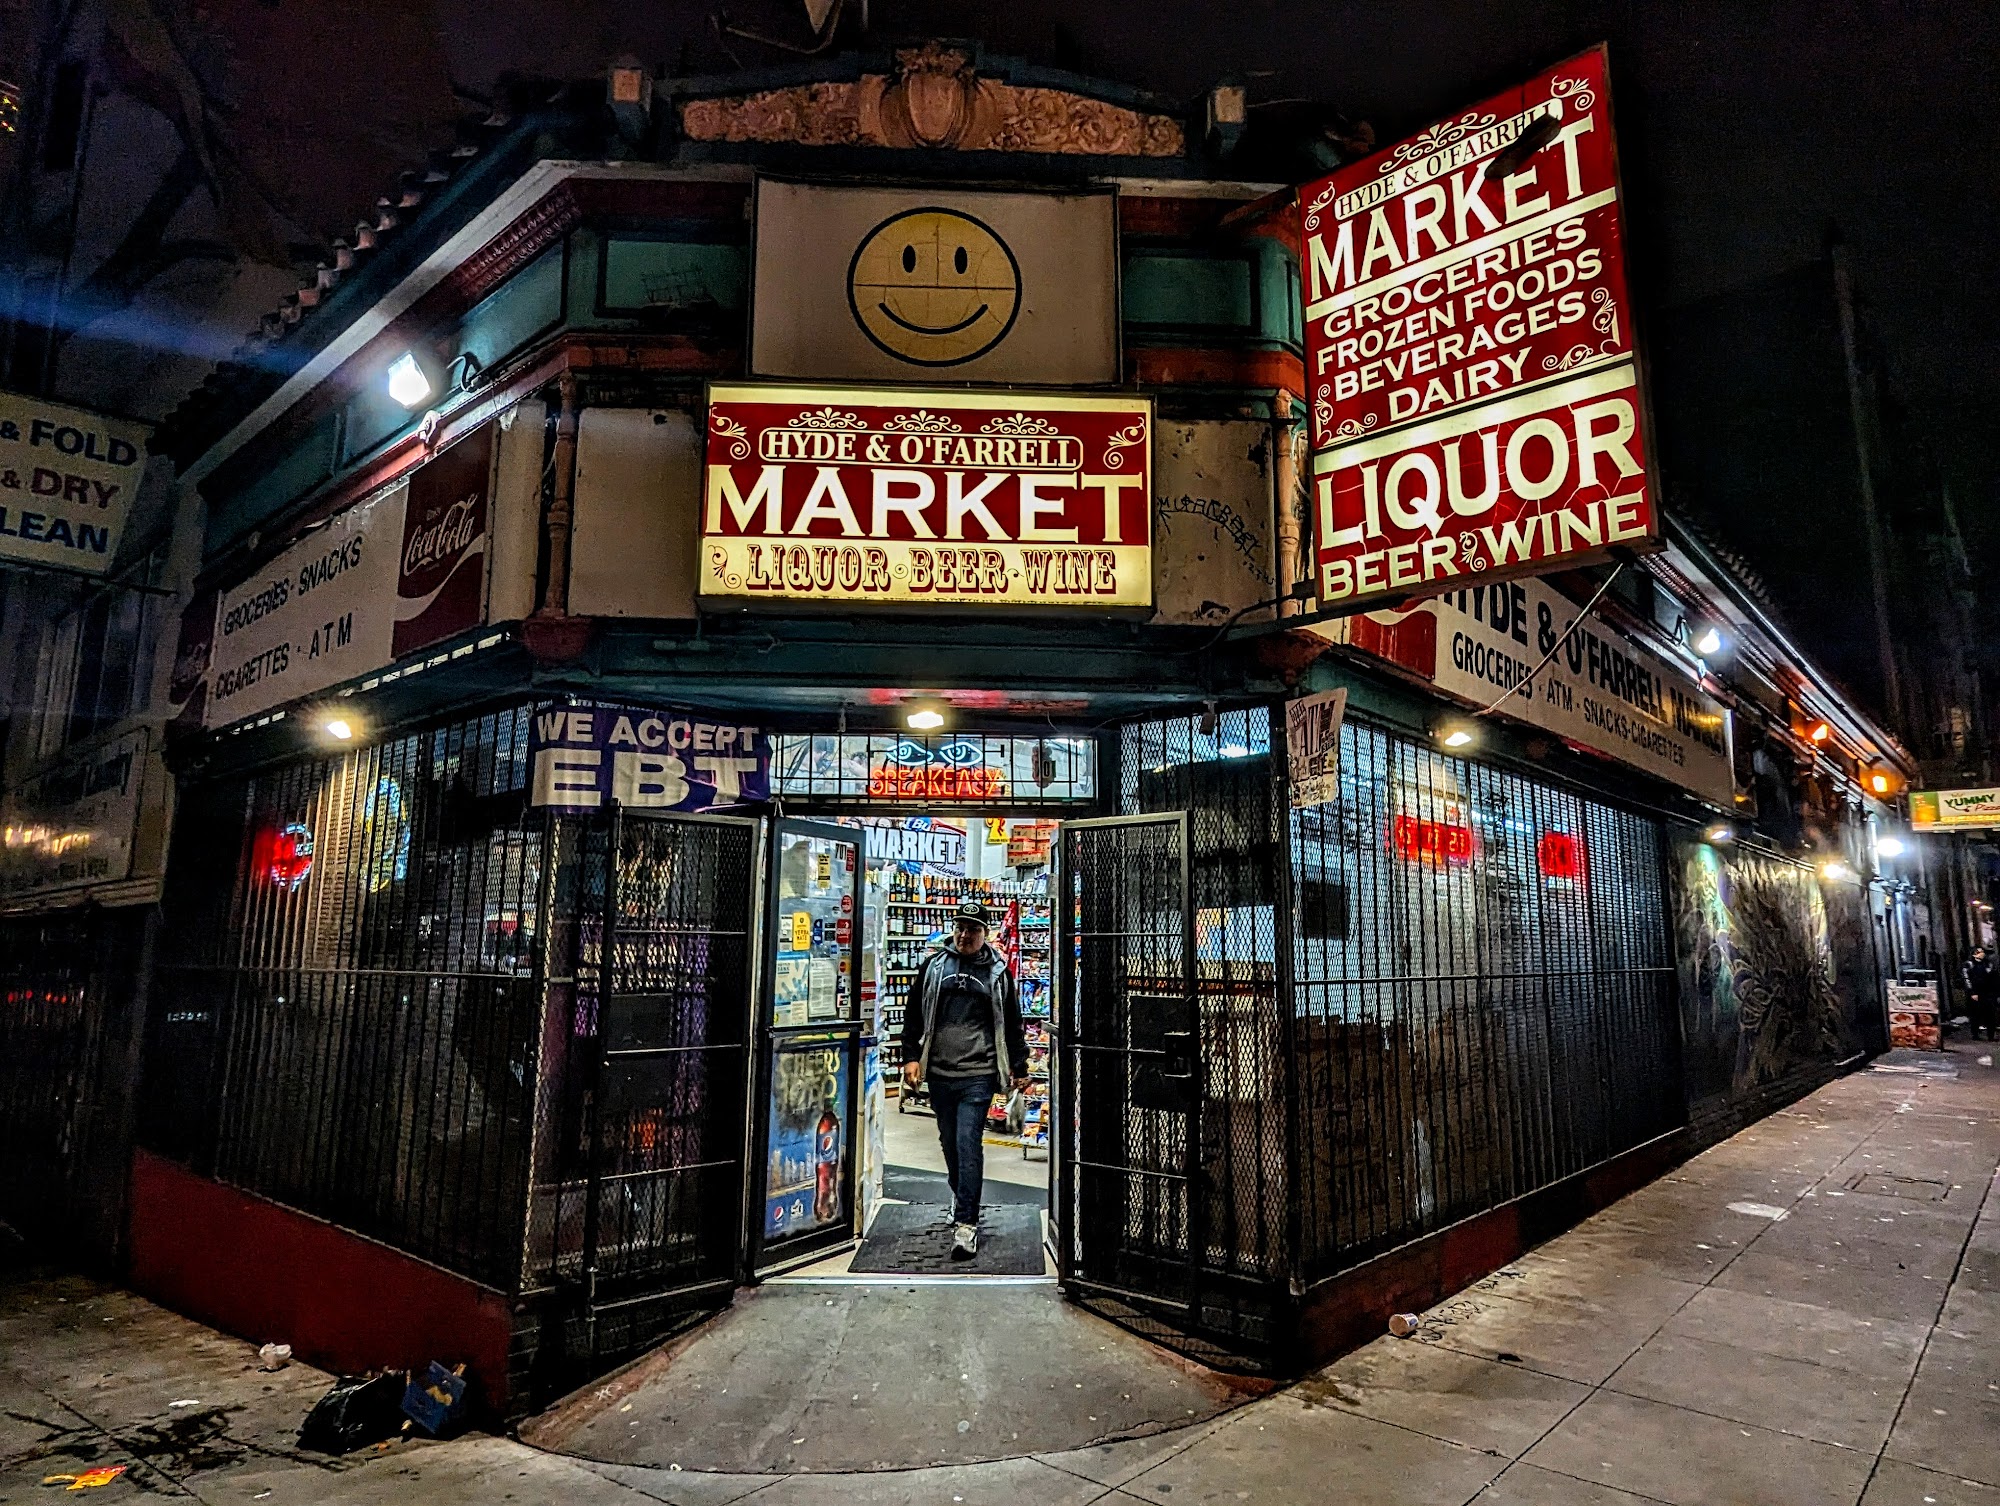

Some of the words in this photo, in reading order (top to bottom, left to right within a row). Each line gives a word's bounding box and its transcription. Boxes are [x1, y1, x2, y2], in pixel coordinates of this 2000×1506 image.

[1308, 113, 1594, 302] MARKET
[1338, 176, 1397, 217] HYDE
[1402, 167, 1420, 188] &
[1324, 217, 1588, 338] GROCERIES
[1317, 300, 1456, 376] FROZEN
[1463, 248, 1602, 322] FOODS
[1334, 292, 1587, 402] BEVERAGES
[1388, 346, 1533, 422] DAIRY
[0, 420, 20, 442] &
[29, 418, 138, 467] FOLD
[765, 431, 857, 461] HYDE
[865, 434, 890, 462] &
[900, 434, 1077, 468] O'FARRELL
[1317, 397, 1646, 551] LIQUOR
[0, 469, 21, 490] &
[31, 466, 122, 510] DRY
[704, 464, 1144, 544] MARKET
[745, 543, 892, 593] LIQUOR
[907, 546, 1009, 594] BEER
[1020, 548, 1118, 595] WINE
[1321, 535, 1462, 602] BEER
[1480, 490, 1647, 567] WINE
[223, 577, 291, 636] GROCERIES
[298, 535, 364, 596] SNACKS
[215, 642, 290, 700] CIGARETTES
[1443, 581, 1529, 648] YDE
[1537, 601, 1561, 665] &
[1565, 619, 1669, 725] O'FARRELL
[1452, 631, 1533, 700] GROCERIES
[1546, 677, 1573, 712] ATM
[537, 711, 594, 744] WE
[608, 713, 760, 752] ACCEPT
[531, 747, 758, 807] EBT
[868, 768, 1004, 796] SPEAKEASY
[1944, 793, 1996, 807] YUMMY
[864, 825, 961, 864] MARKET
